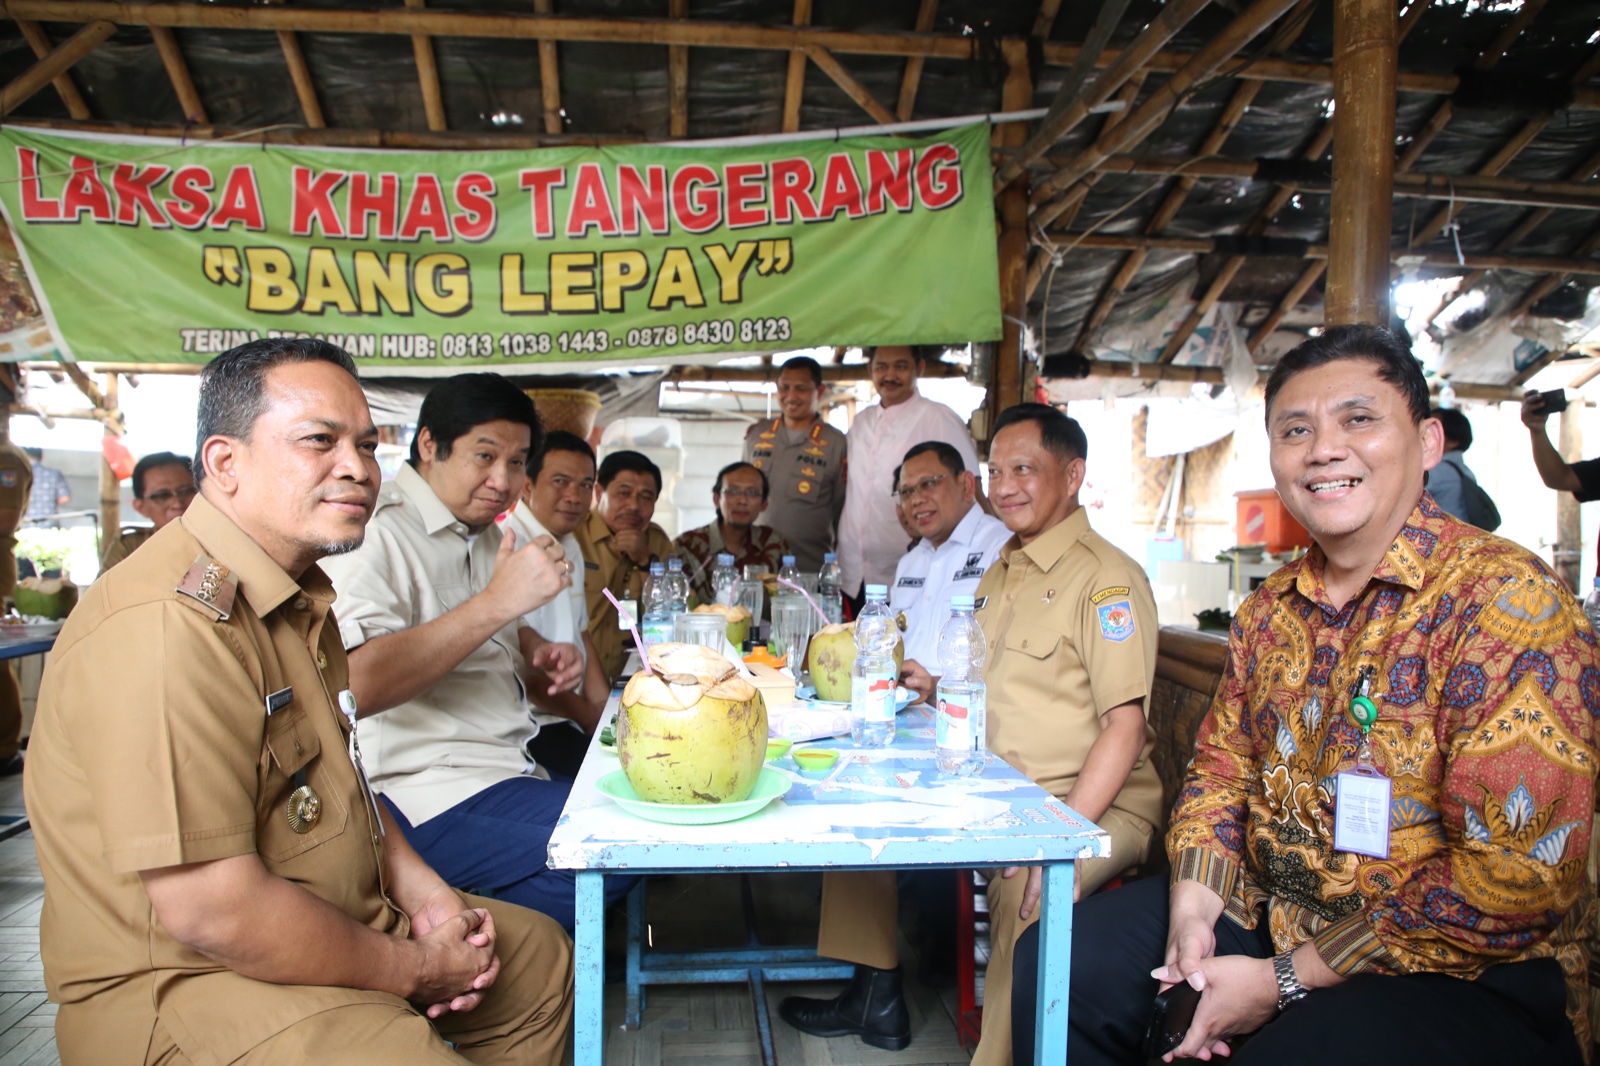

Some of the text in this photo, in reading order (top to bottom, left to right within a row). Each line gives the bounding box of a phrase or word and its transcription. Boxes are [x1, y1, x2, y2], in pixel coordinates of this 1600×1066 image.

[16, 143, 964, 243] LAKSA KHAS TANGERANG
[381, 334, 436, 359] HUB:
[442, 333, 493, 359] 0813
[499, 332, 551, 355] 1038
[557, 330, 609, 353] 1443
[627, 324, 678, 348] 0878
[683, 319, 735, 344] 8430
[740, 317, 792, 342] 8123
[797, 455, 827, 468] POLRI
